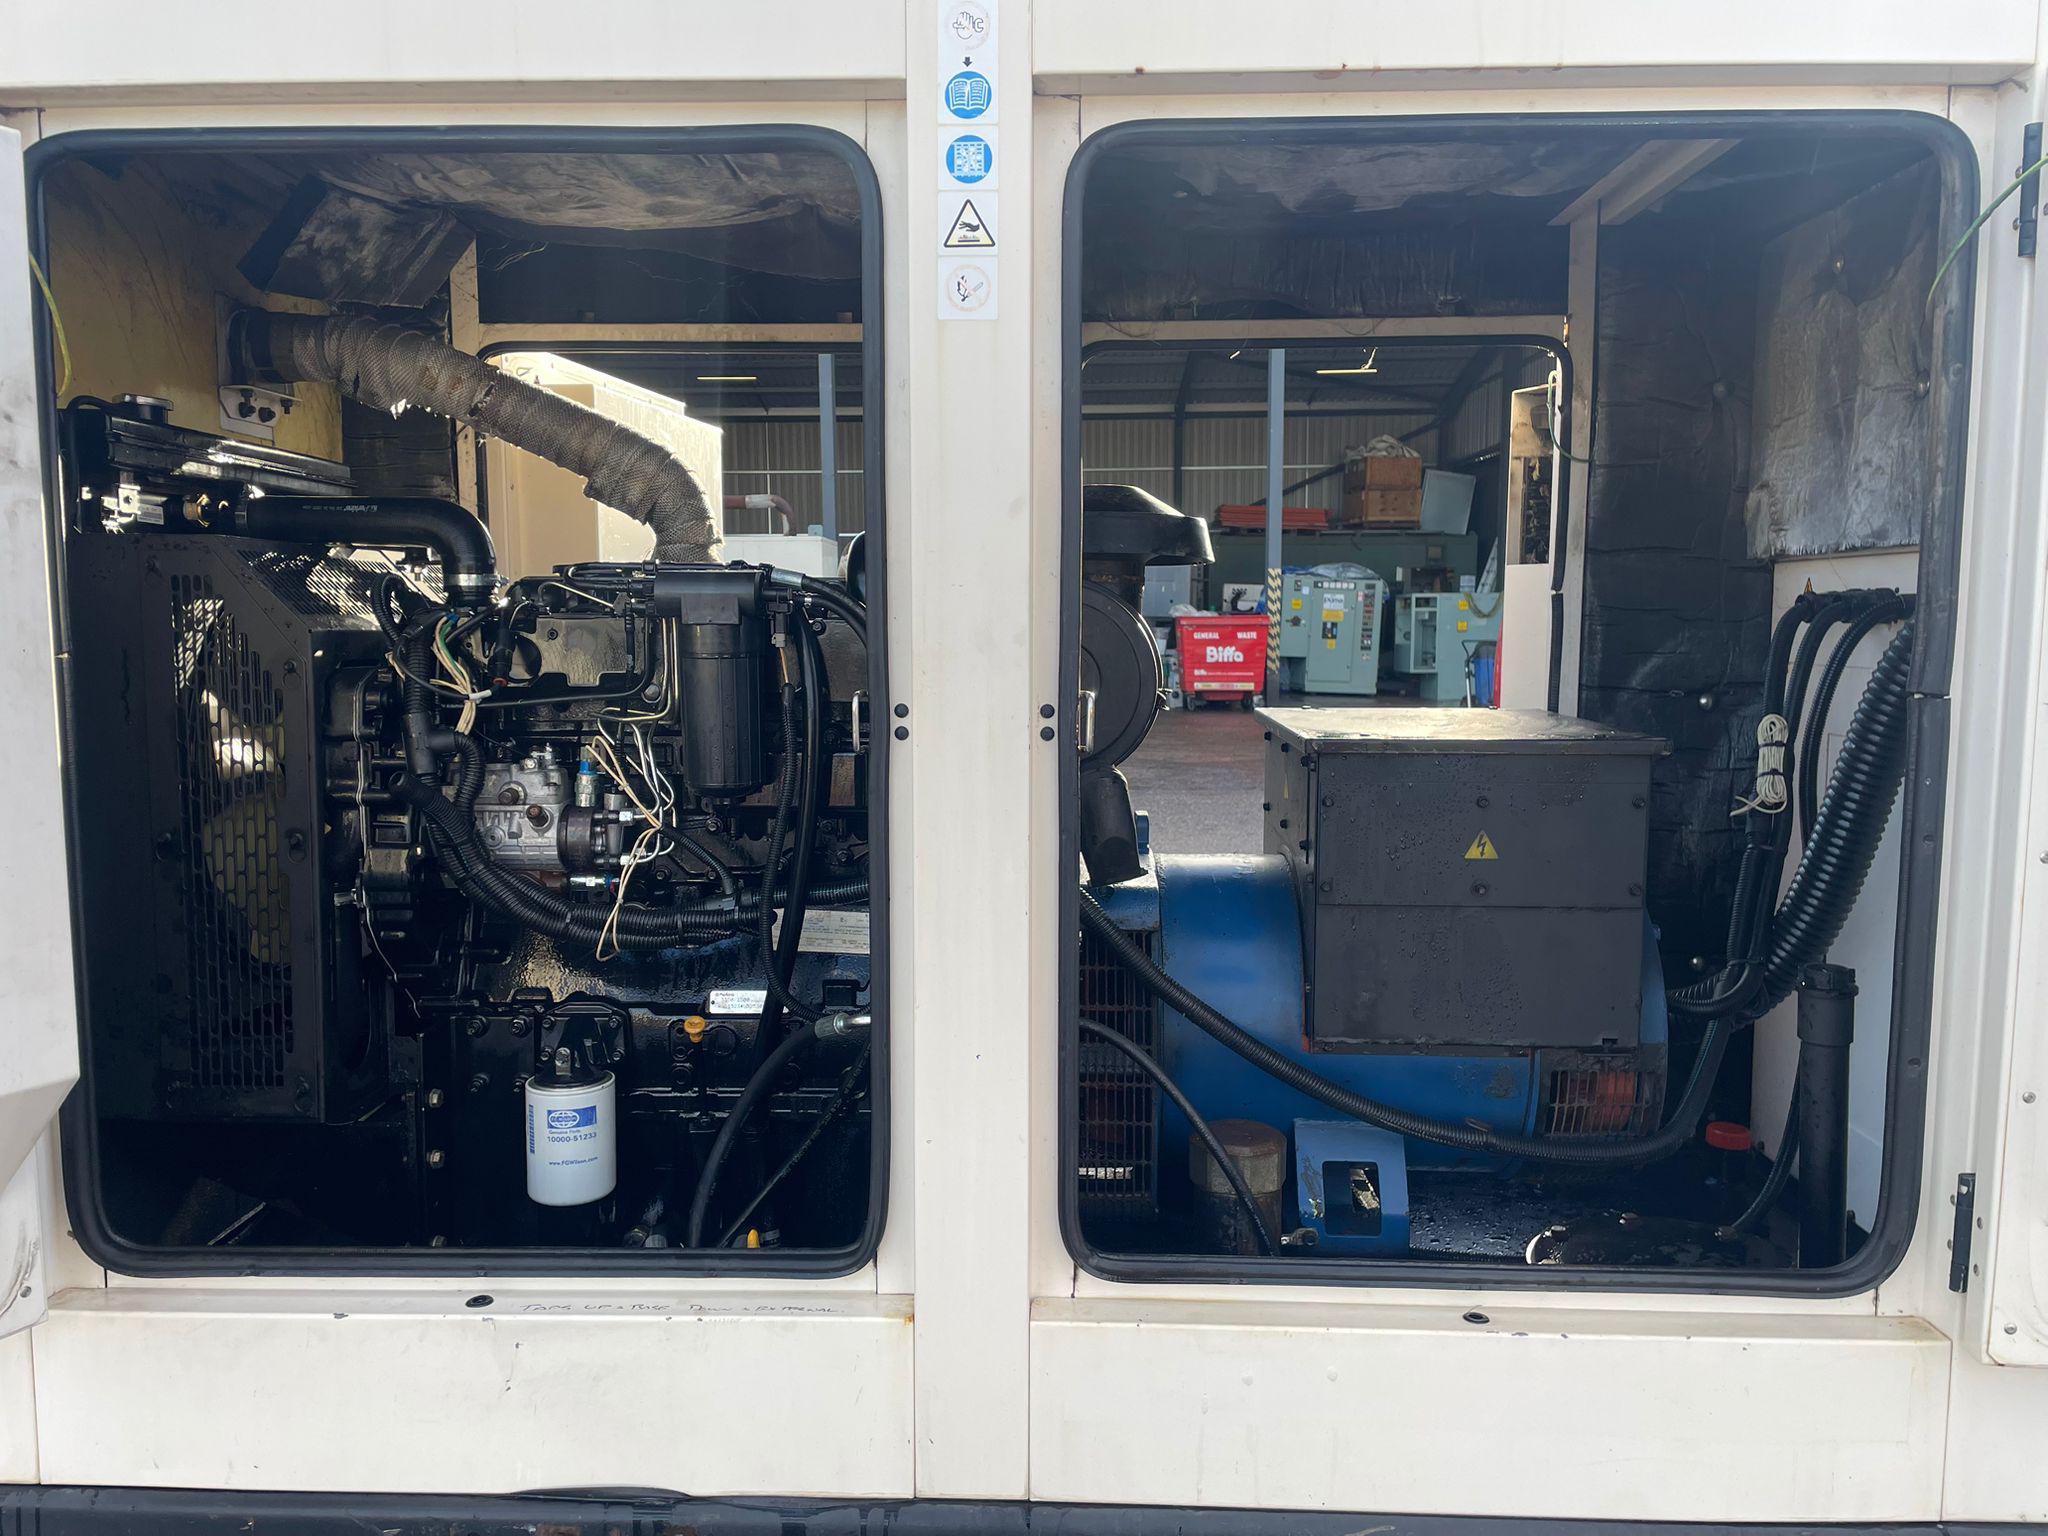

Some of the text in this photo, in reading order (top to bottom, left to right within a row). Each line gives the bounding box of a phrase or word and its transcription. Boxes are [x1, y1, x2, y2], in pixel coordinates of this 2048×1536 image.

[1193, 631, 1258, 640] GENERAL WASTE
[1205, 646, 1244, 662] Biffa
[547, 1132, 597, 1142] 10000-51233
